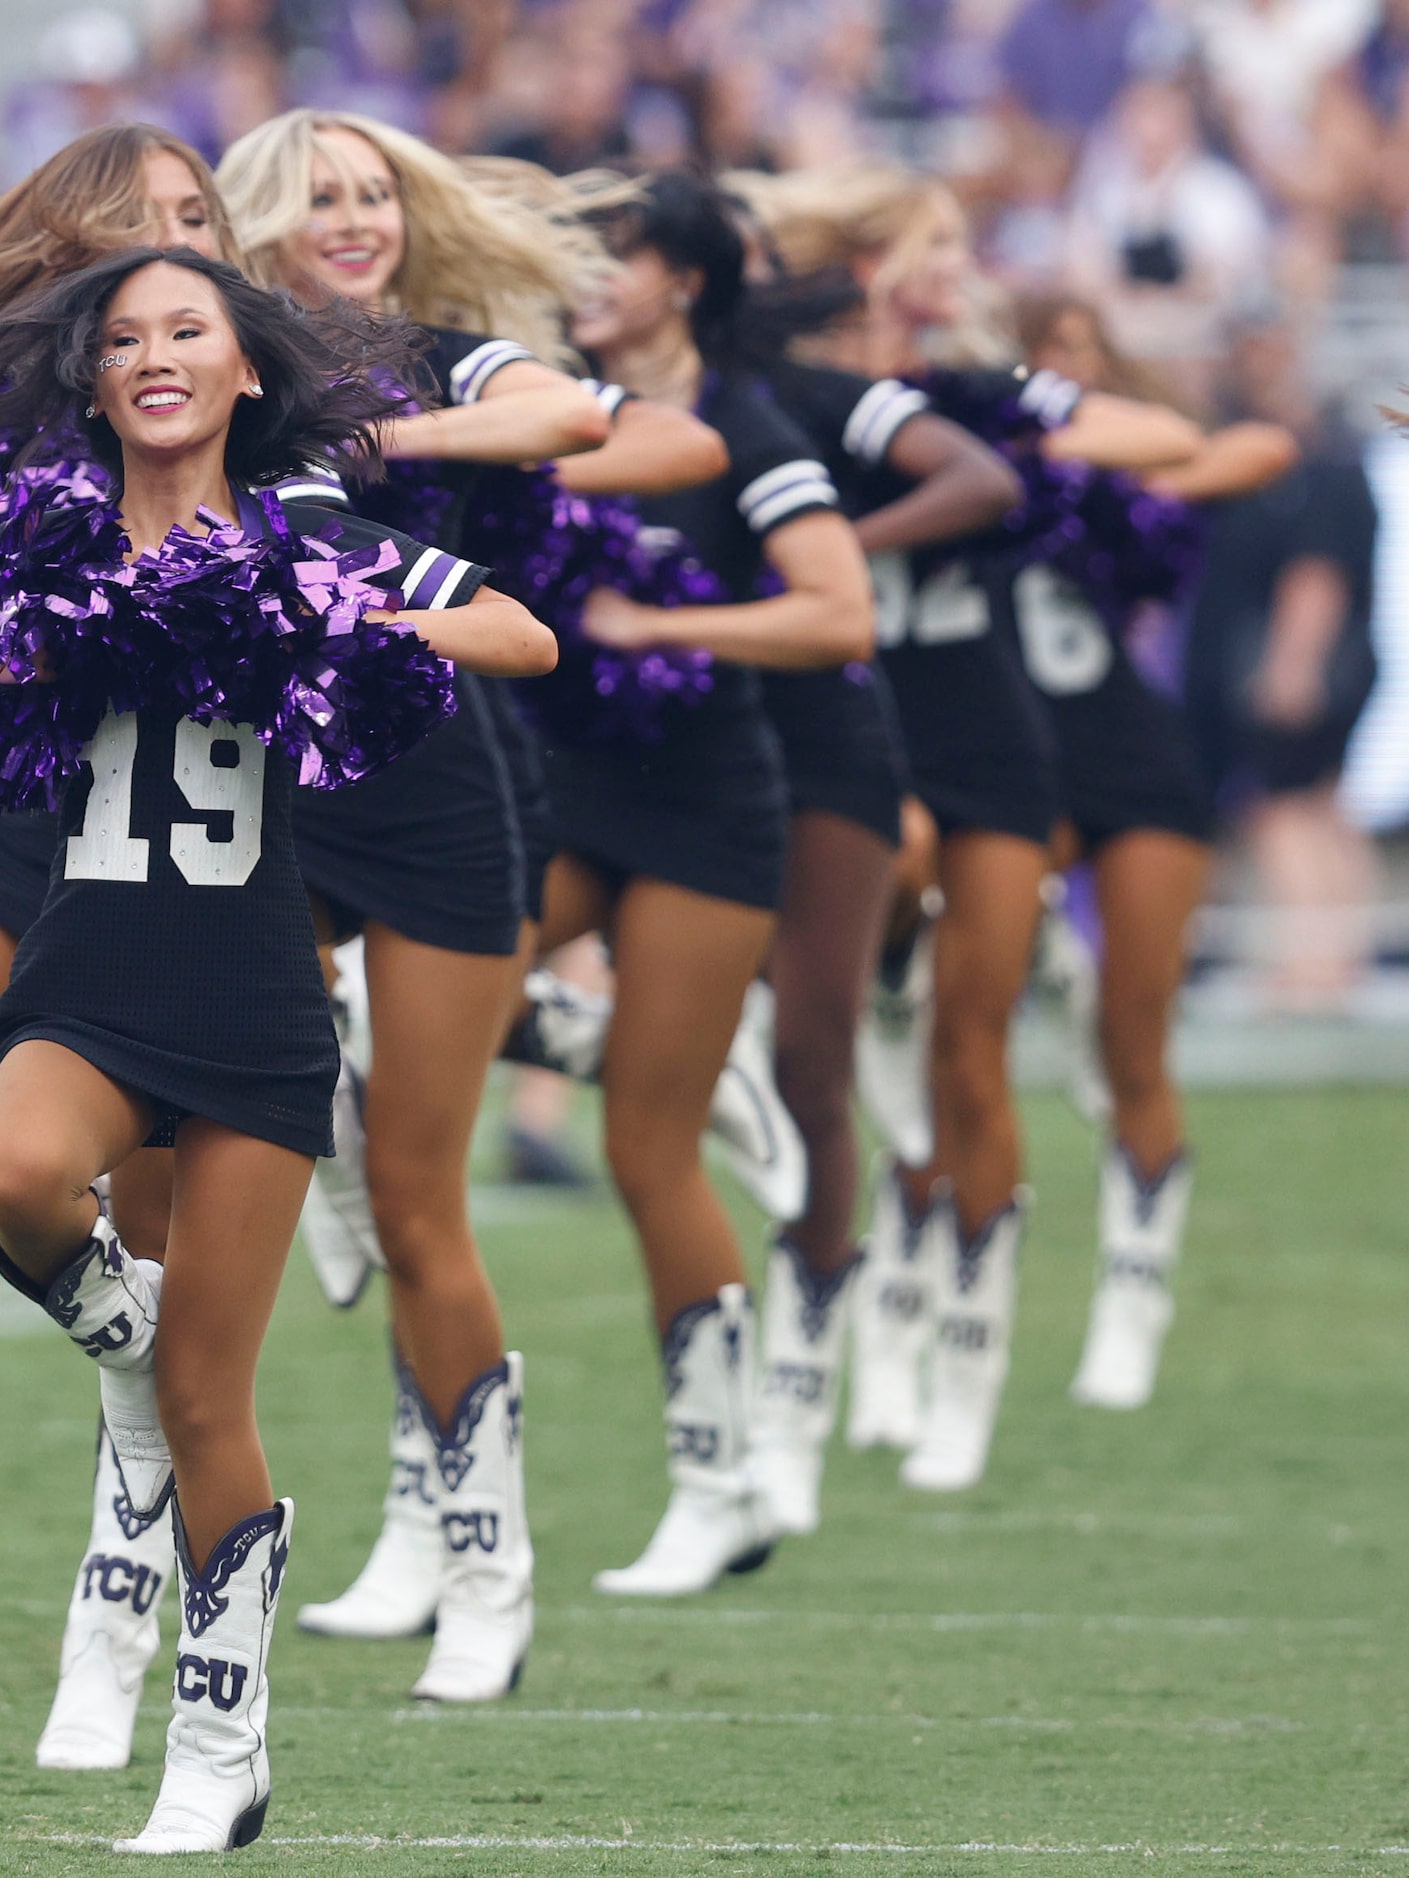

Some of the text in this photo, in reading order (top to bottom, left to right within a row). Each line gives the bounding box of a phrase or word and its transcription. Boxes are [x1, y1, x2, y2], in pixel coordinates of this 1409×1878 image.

[99, 355, 126, 373] TCU
[64, 697, 266, 886] 19
[233, 1526, 260, 1551] TCU
[82, 1552, 163, 1616] TCU
[172, 1651, 249, 1713] CU
